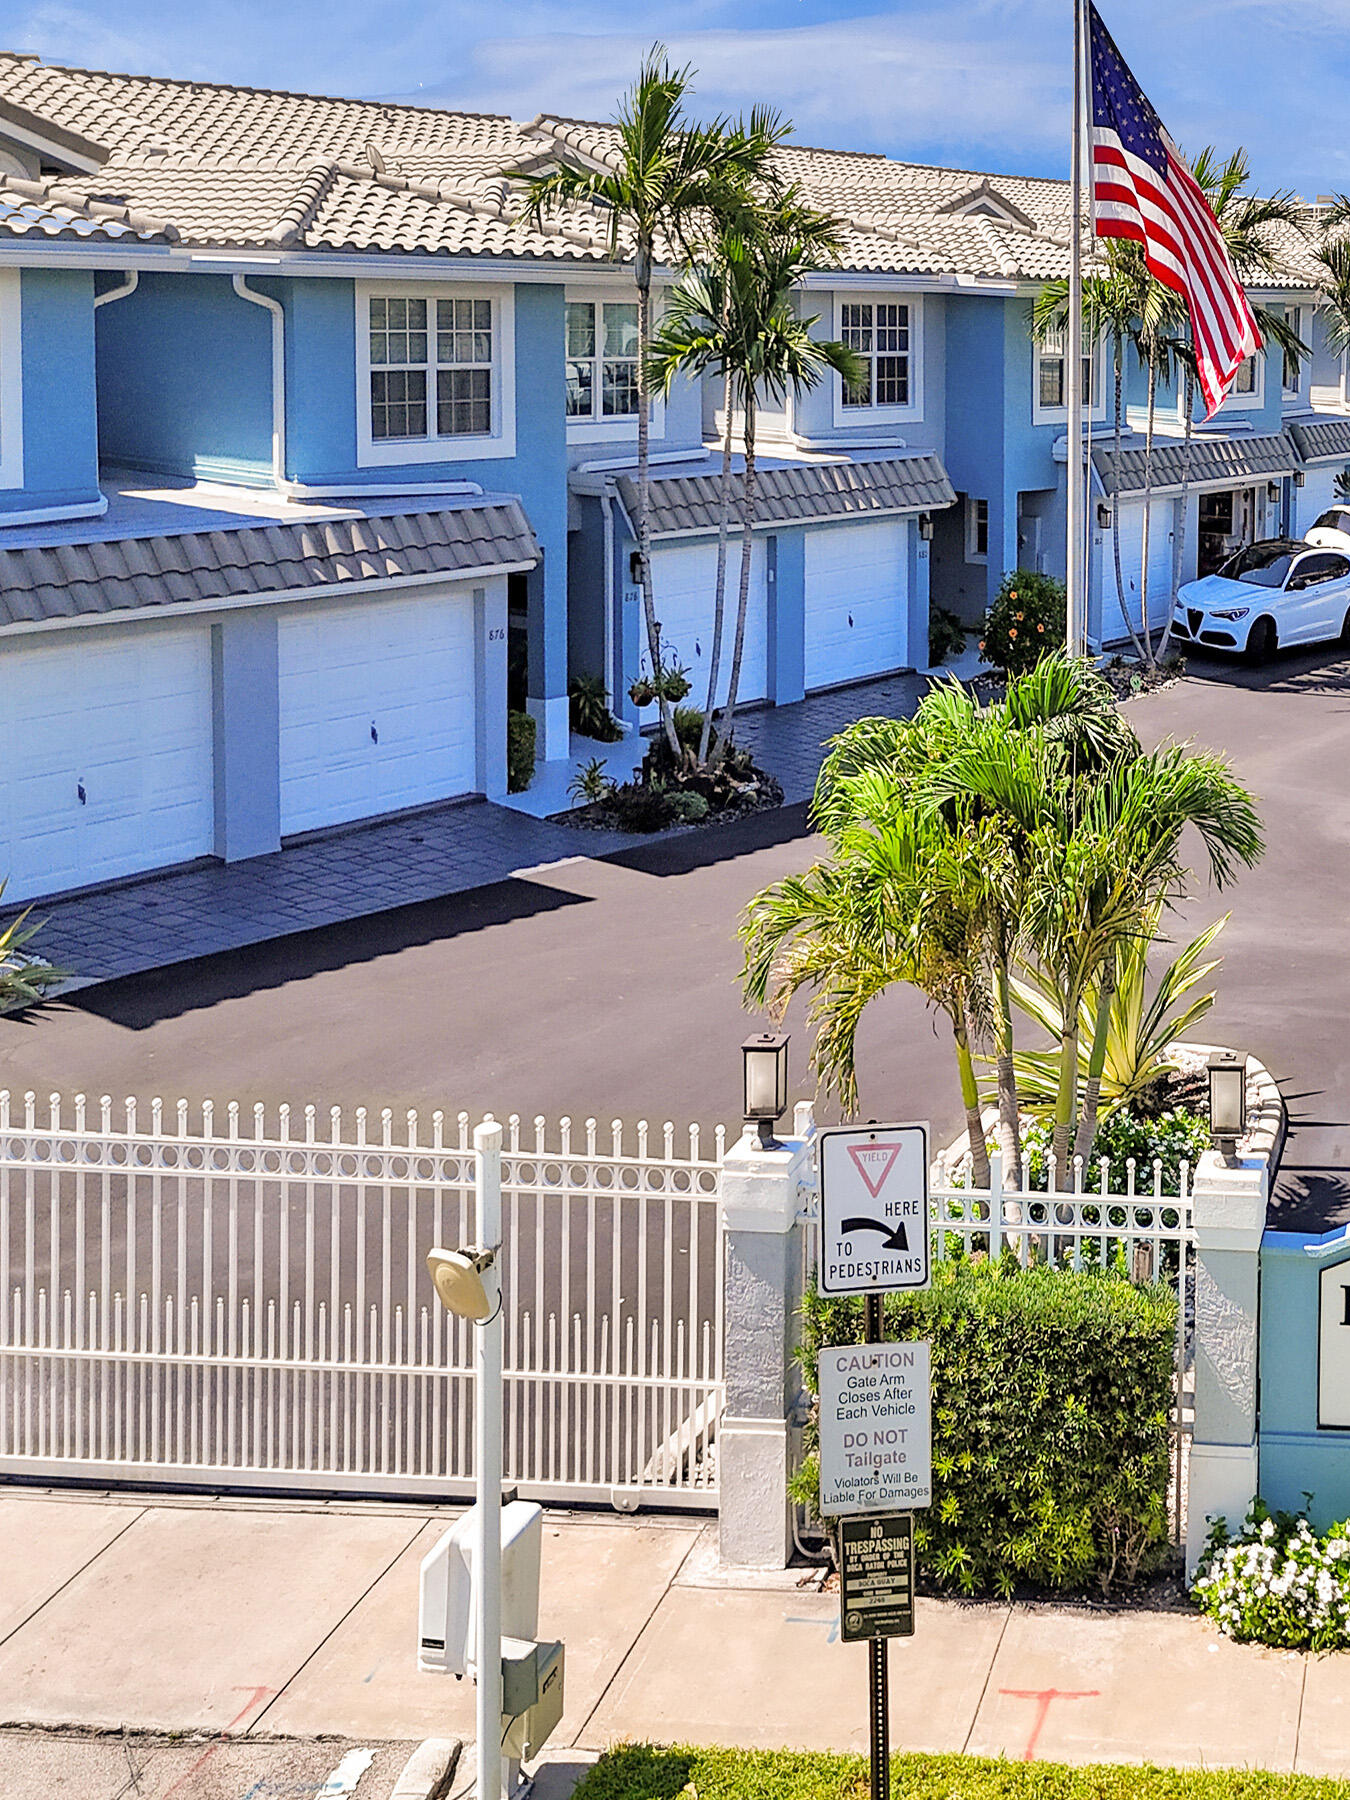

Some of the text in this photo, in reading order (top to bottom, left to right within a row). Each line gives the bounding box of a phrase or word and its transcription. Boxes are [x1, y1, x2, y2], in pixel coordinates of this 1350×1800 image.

[489, 628, 505, 641] 876
[861, 1151, 888, 1163] YIELD
[885, 1200, 919, 1217] HERE
[836, 1242, 852, 1257] TO
[829, 1258, 922, 1280] PEDESTRIANS
[836, 1352, 914, 1372] CAUTION
[847, 1373, 905, 1389] Gate Arm
[838, 1387, 912, 1405] Closes After
[836, 1402, 916, 1420] Each Vehicle
[844, 1428, 908, 1448] DO NOT
[845, 1450, 907, 1468] Tailgate
[834, 1472, 918, 1489] Violators Will Be
[823, 1487, 929, 1504] Liable For Damages
[870, 1525, 883, 1539] NO
[844, 1536, 909, 1556] TRESPASSING
